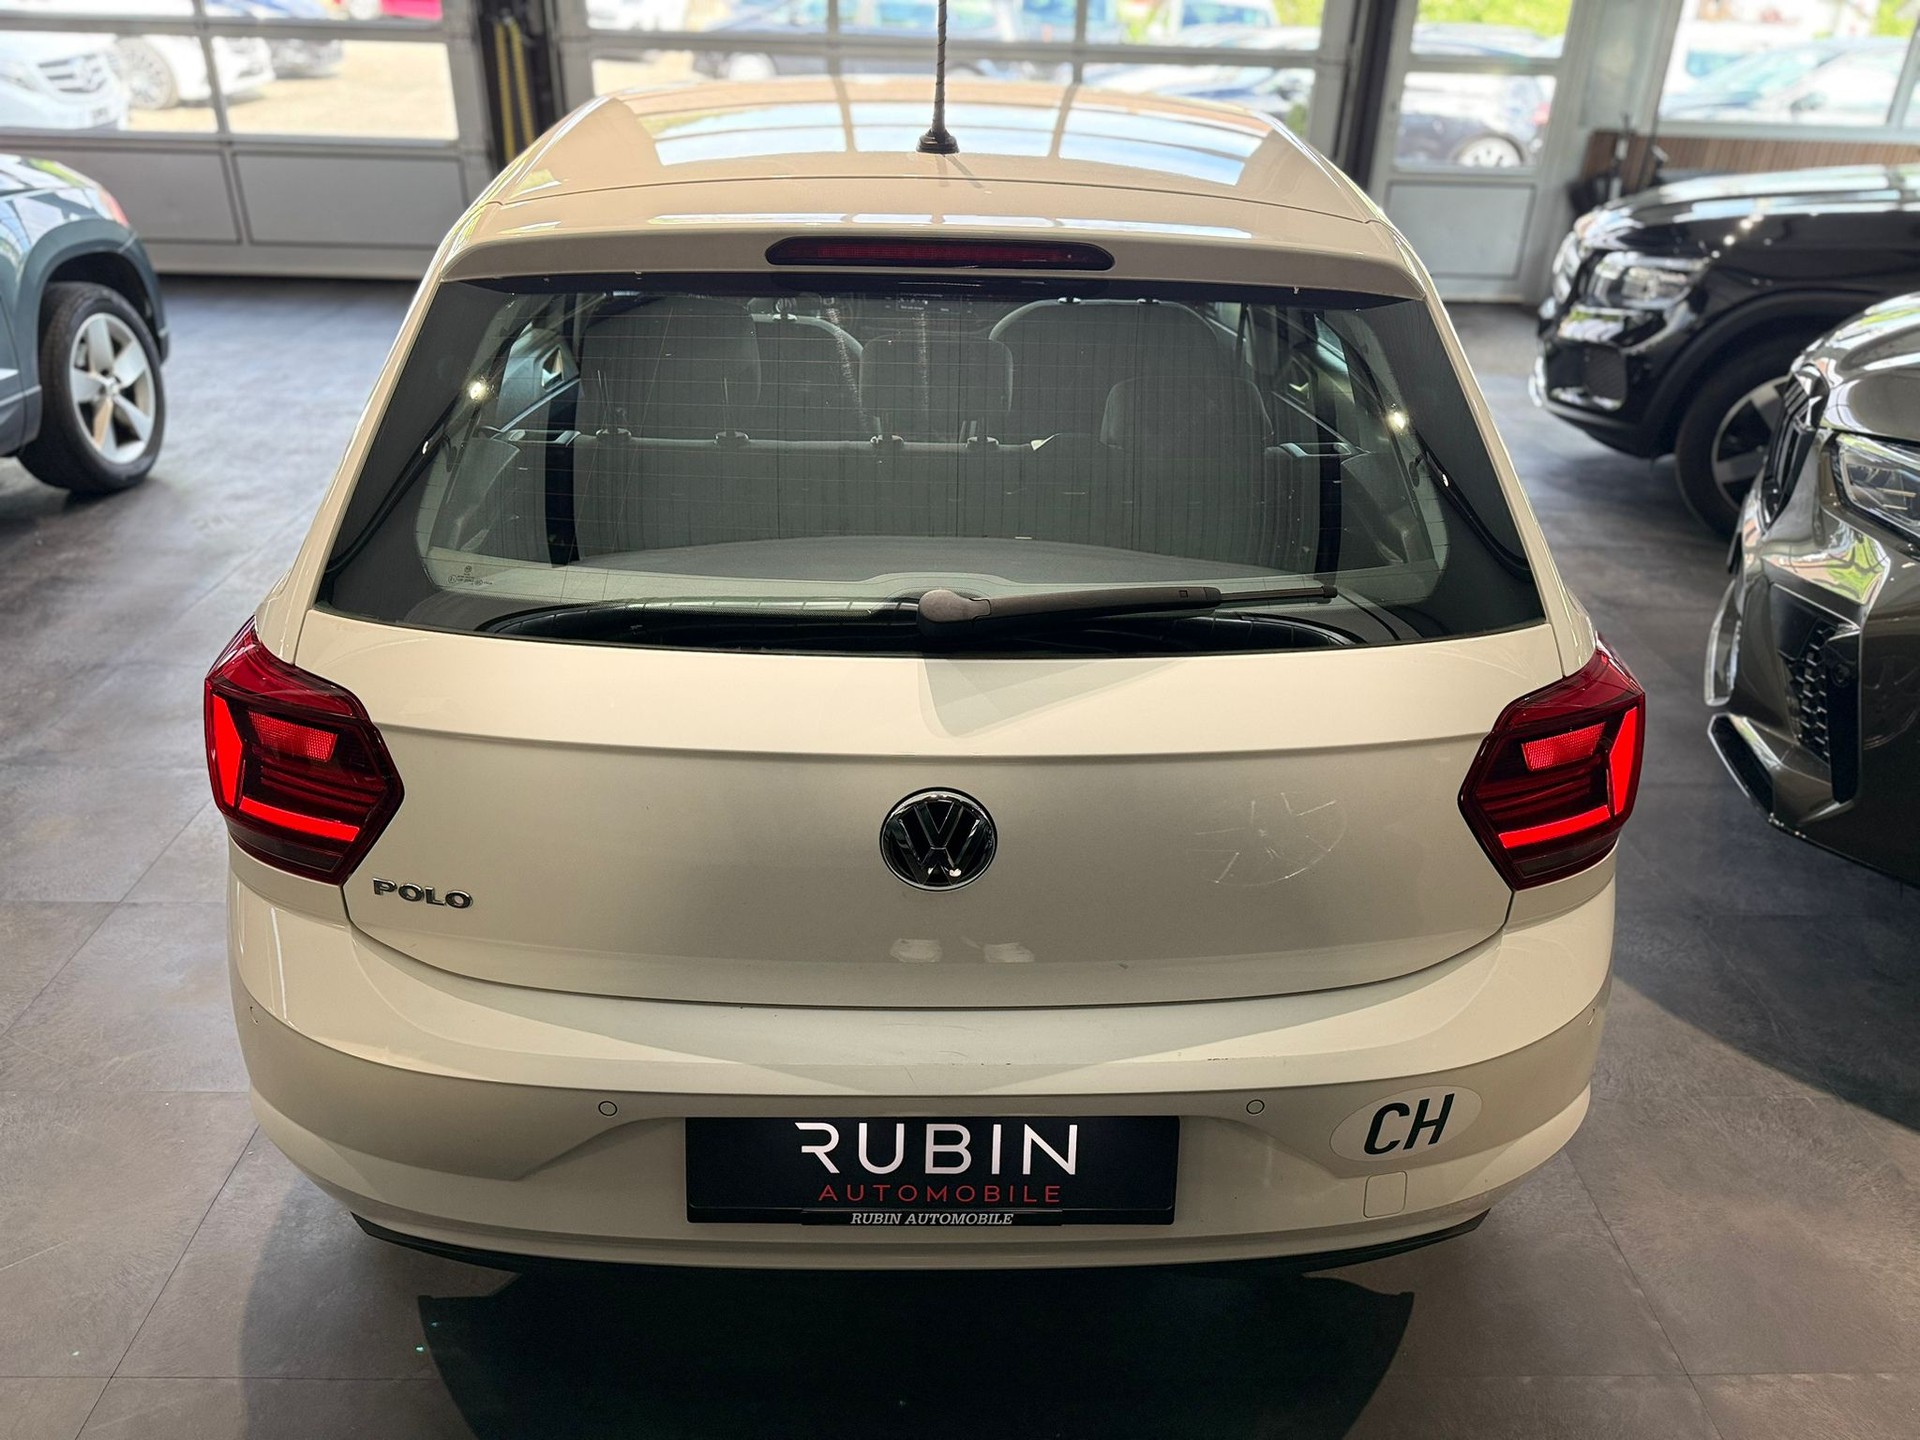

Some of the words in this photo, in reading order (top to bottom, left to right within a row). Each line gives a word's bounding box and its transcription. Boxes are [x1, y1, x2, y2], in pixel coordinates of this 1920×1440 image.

[882, 793, 995, 889] VW
[372, 877, 473, 909] POLO
[1363, 1092, 1456, 1155] CH
[794, 1122, 1078, 1175] RUBIN
[818, 1184, 1061, 1203] AUTOMOBILE
[850, 1212, 903, 1225] RUBIN
[904, 1212, 1014, 1225] AUTOMOBILE
